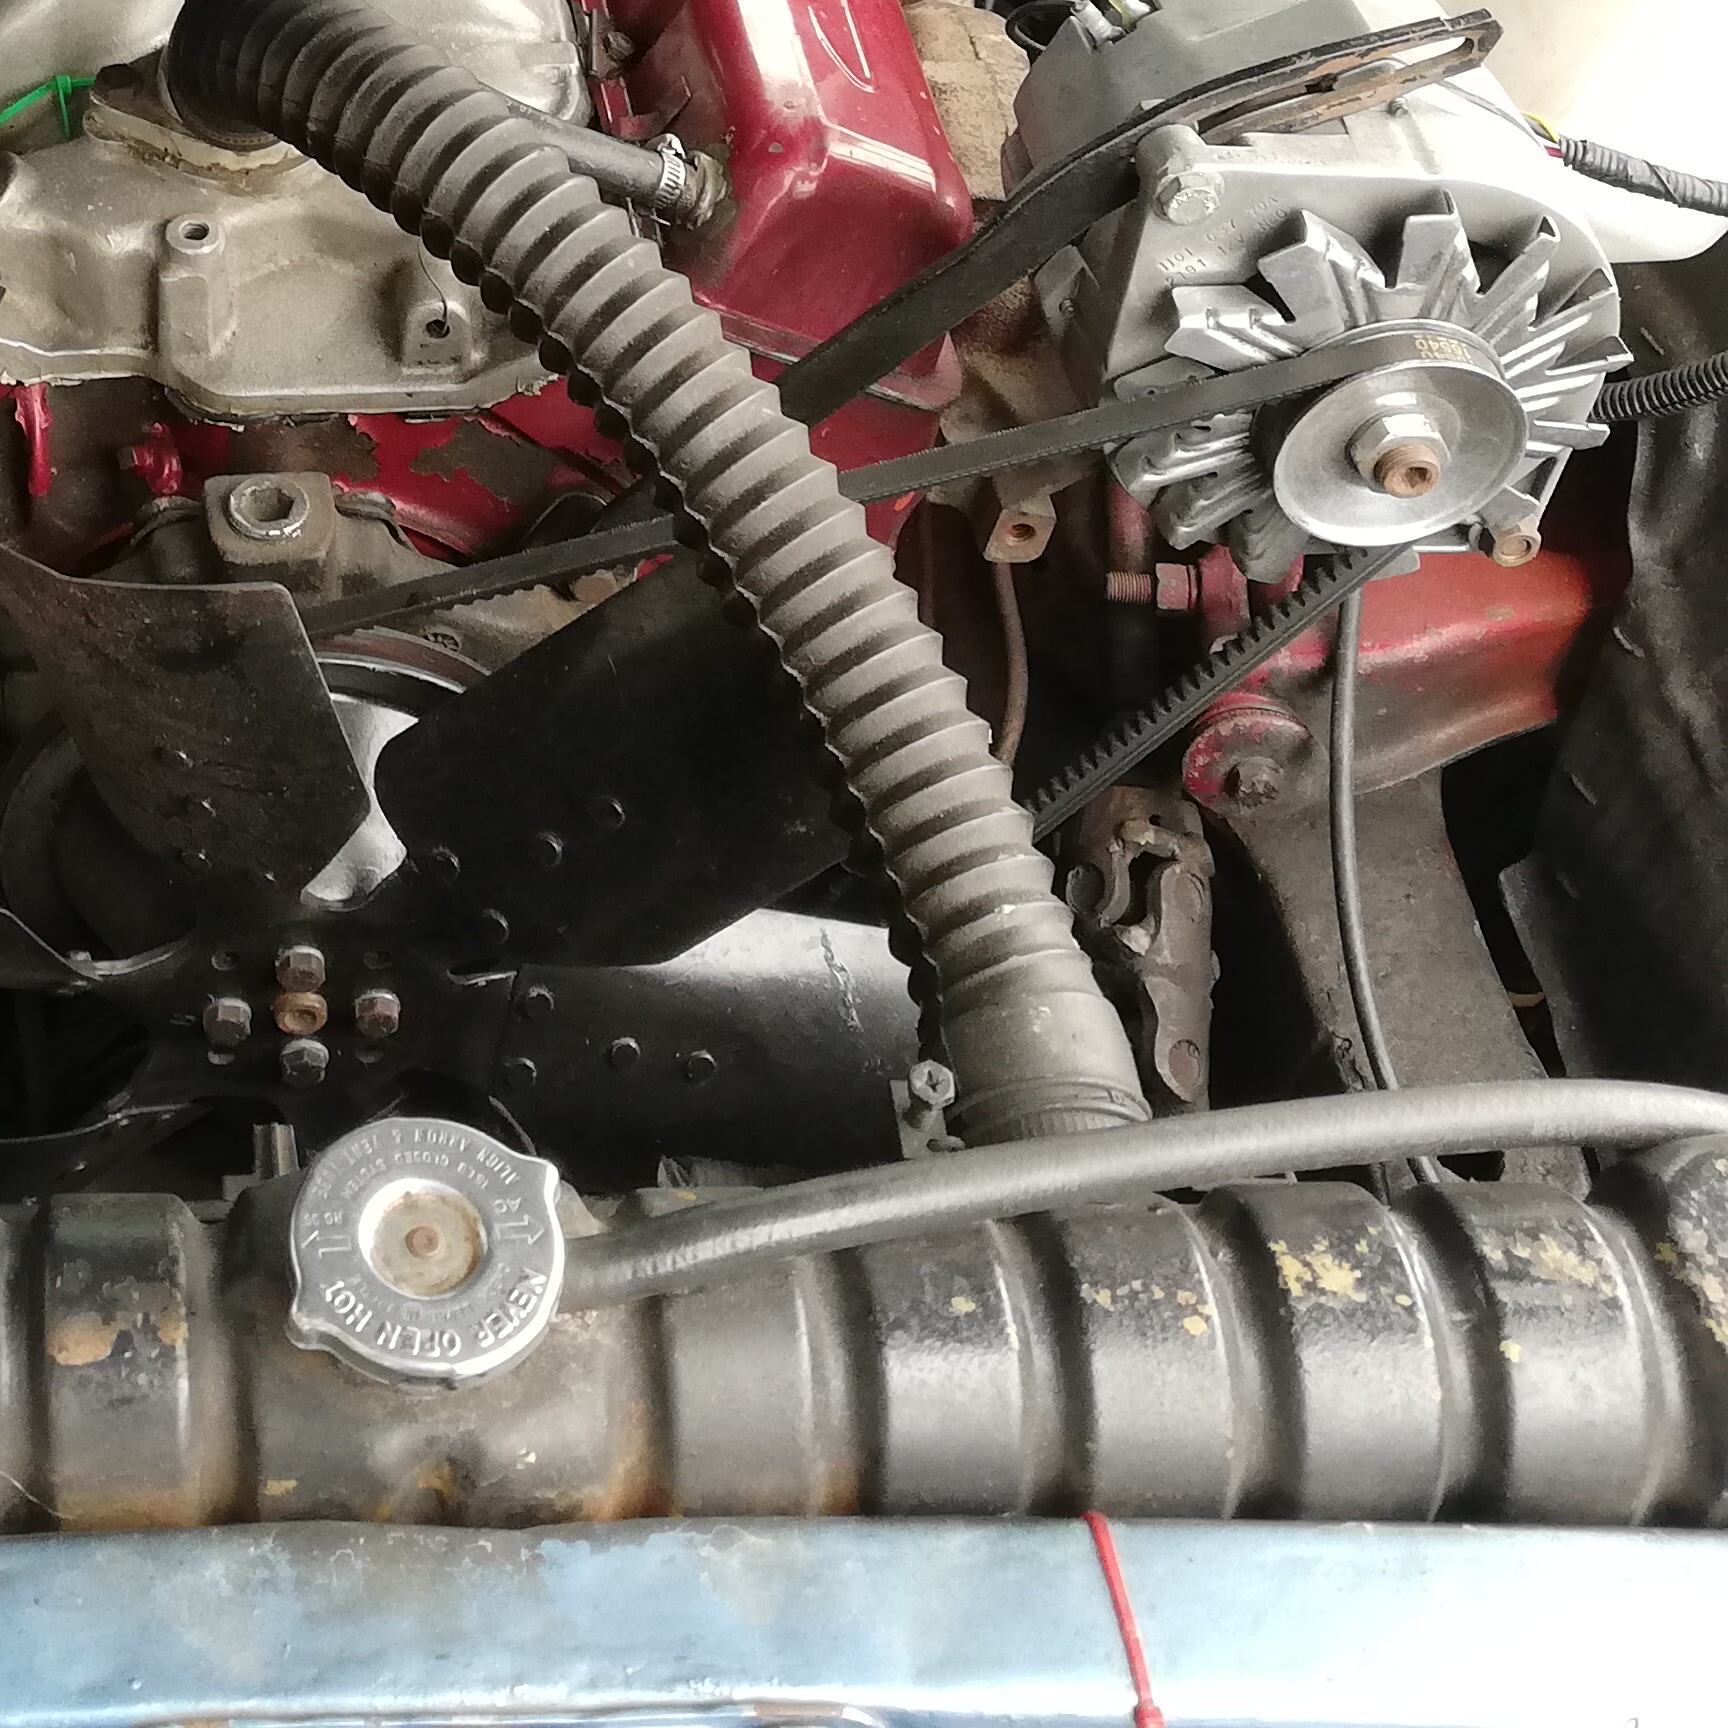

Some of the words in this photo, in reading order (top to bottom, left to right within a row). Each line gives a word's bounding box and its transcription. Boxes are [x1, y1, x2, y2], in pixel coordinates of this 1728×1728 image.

[325, 1279, 373, 1333] HOT
[478, 1267, 547, 1349] NEVER
[377, 1322, 462, 1357] OPEN
